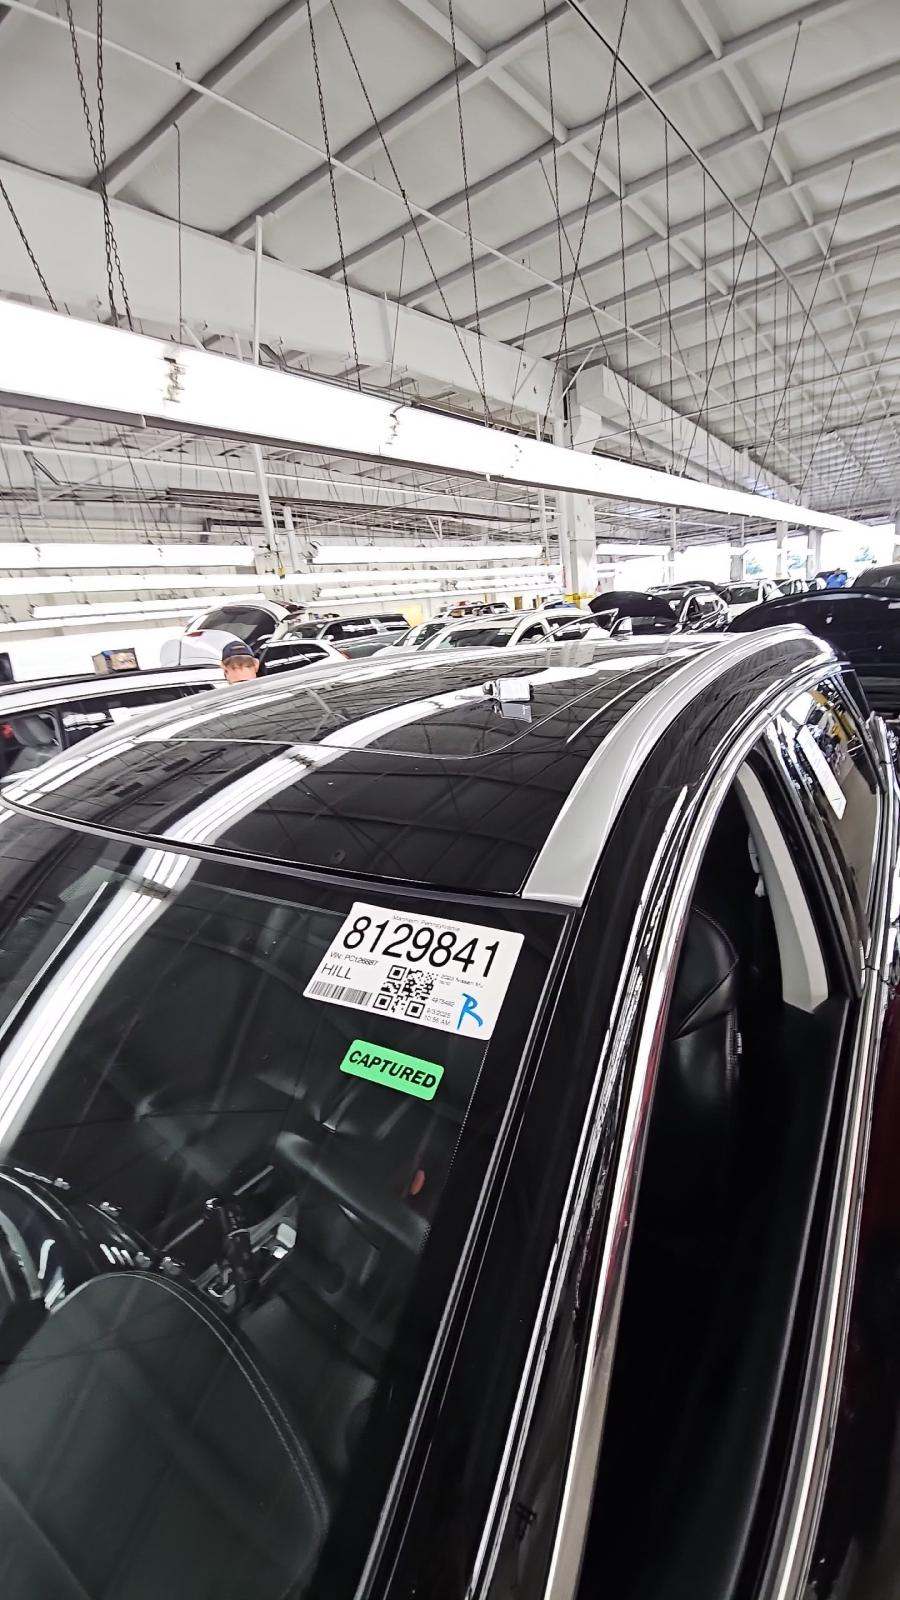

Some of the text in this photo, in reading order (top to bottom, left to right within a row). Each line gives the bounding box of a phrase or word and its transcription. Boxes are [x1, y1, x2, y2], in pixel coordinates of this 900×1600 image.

[343, 916, 500, 978] 8129841
[321, 962, 352, 980] HILL
[457, 992, 483, 1030] R
[349, 1050, 437, 1089] CAPTURED
